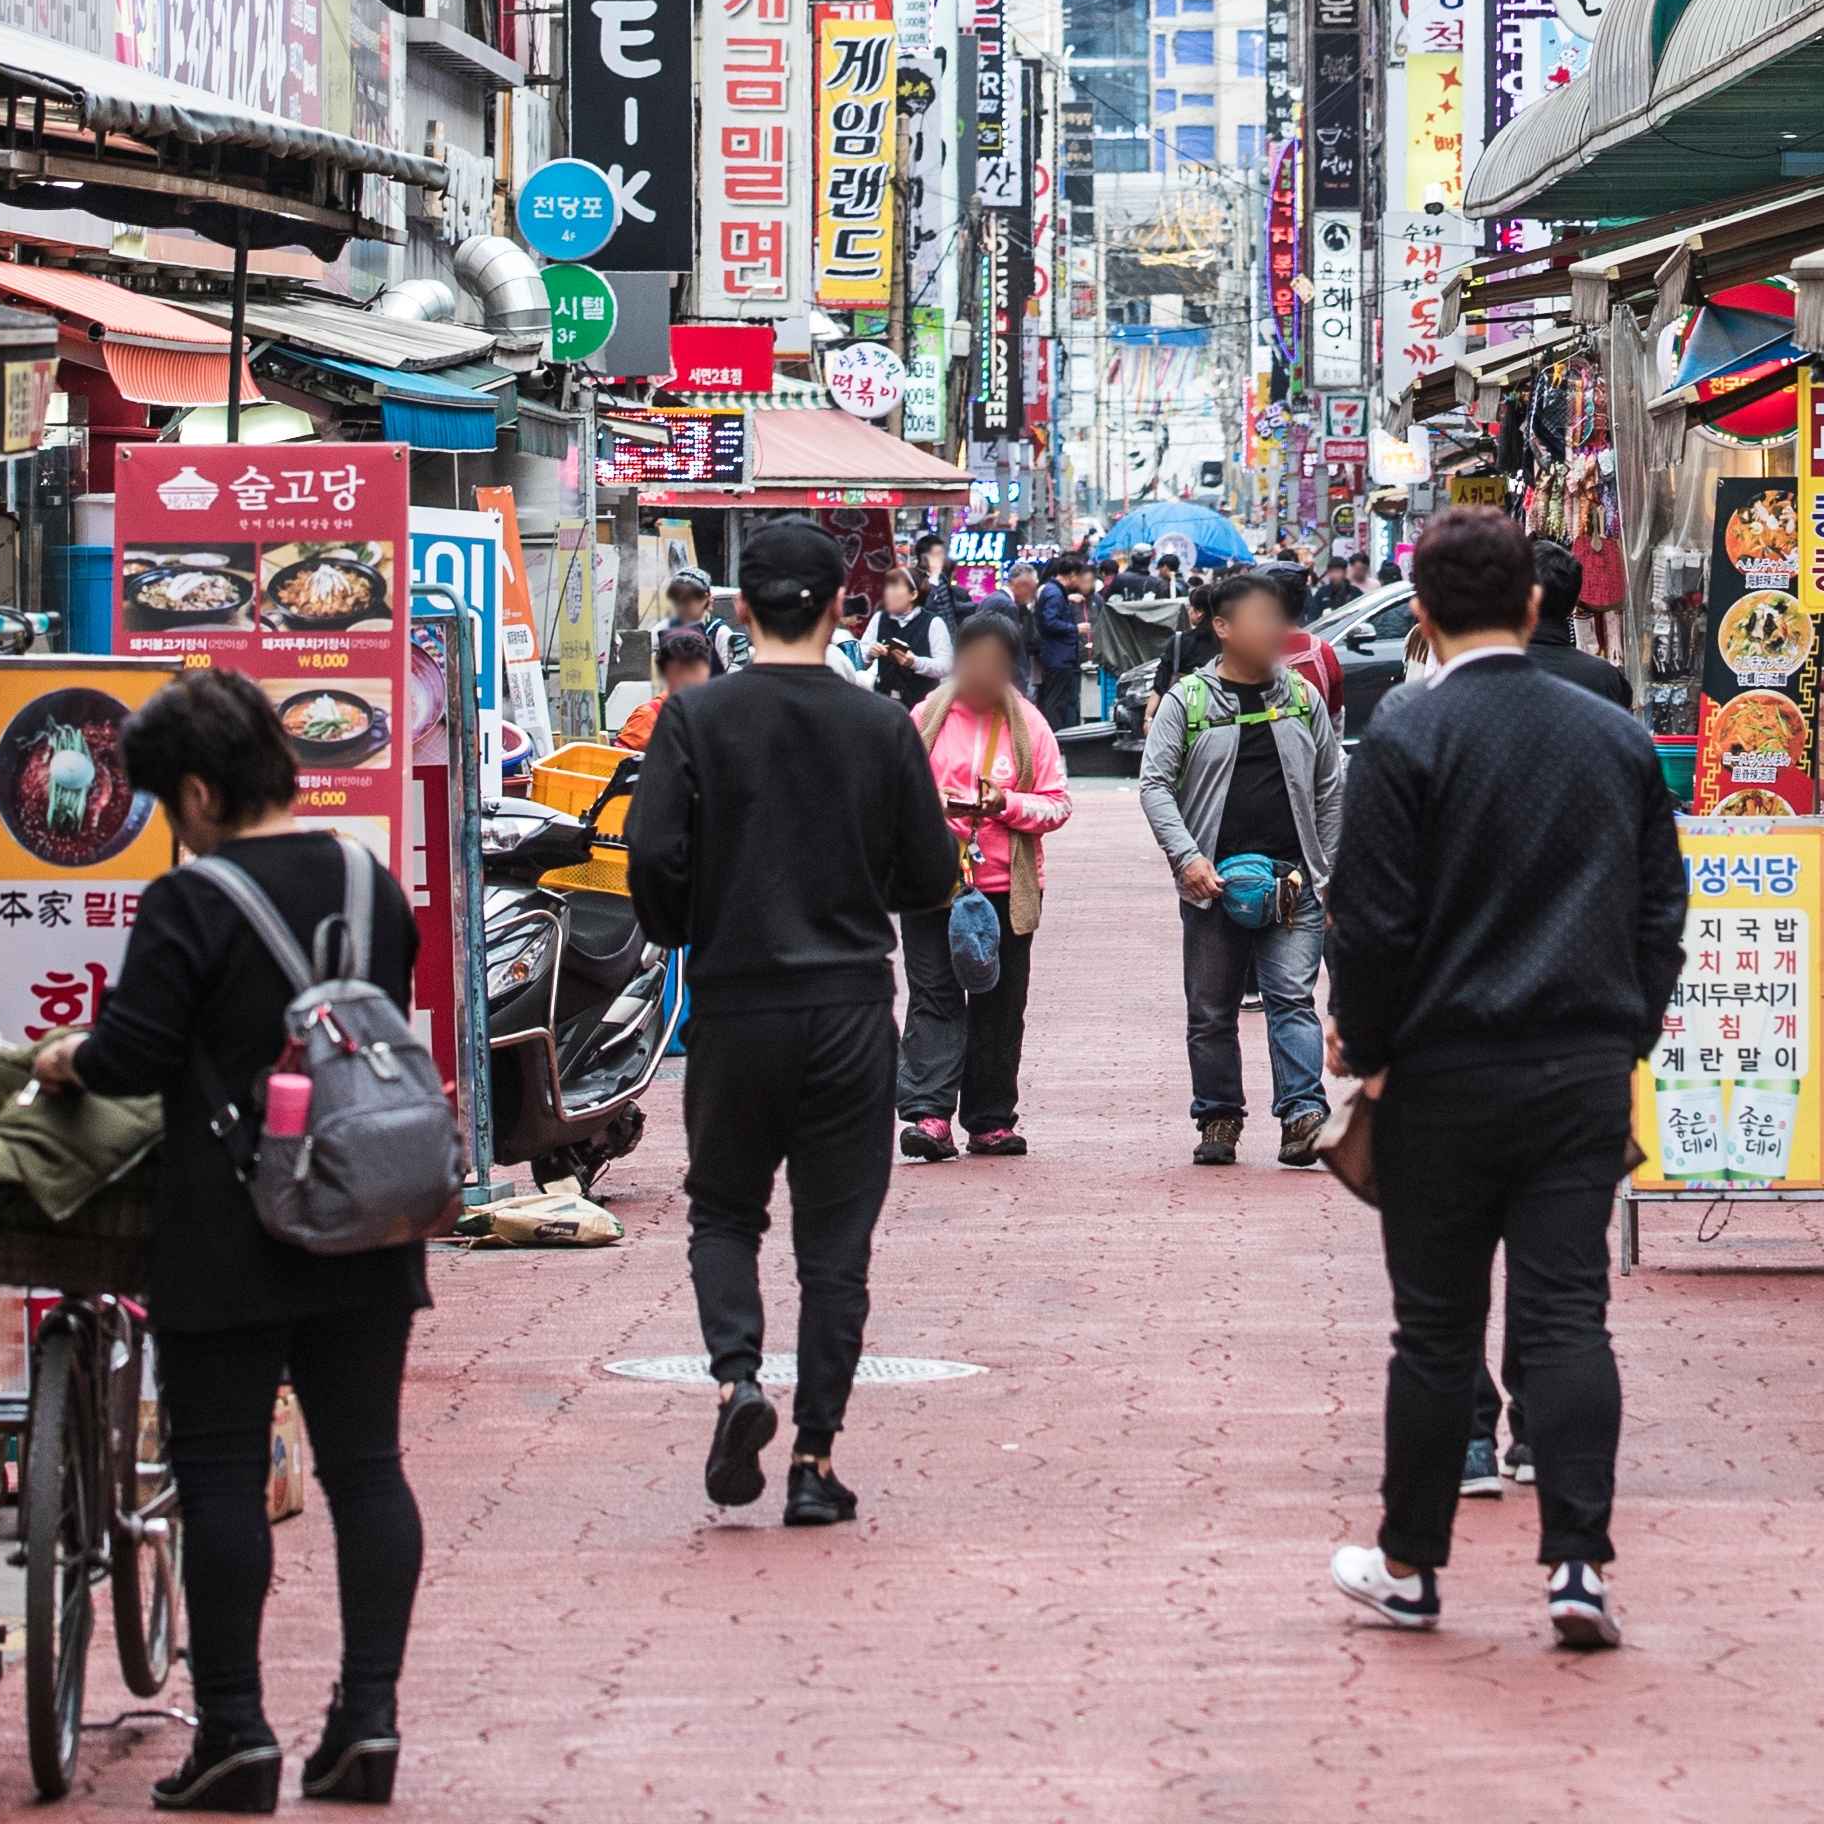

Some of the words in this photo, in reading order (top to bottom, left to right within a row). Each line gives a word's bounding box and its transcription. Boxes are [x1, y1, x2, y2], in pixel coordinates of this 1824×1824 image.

[824, 36, 894, 280] 게임랜드
[532, 195, 604, 220] 전당포
[689, 367, 742, 384] 서면2호점
[833, 373, 898, 408] 떡볶이
[229, 465, 366, 512] 술고당
[1662, 1014, 1797, 1040] 부침개
[1662, 1047, 1797, 1072] 계란말이
[1669, 1107, 1707, 1138] 좋은
[1738, 1105, 1776, 1138] 좋은
[1682, 1132, 1719, 1155] 데이
[1744, 1136, 1782, 1158] 데이
